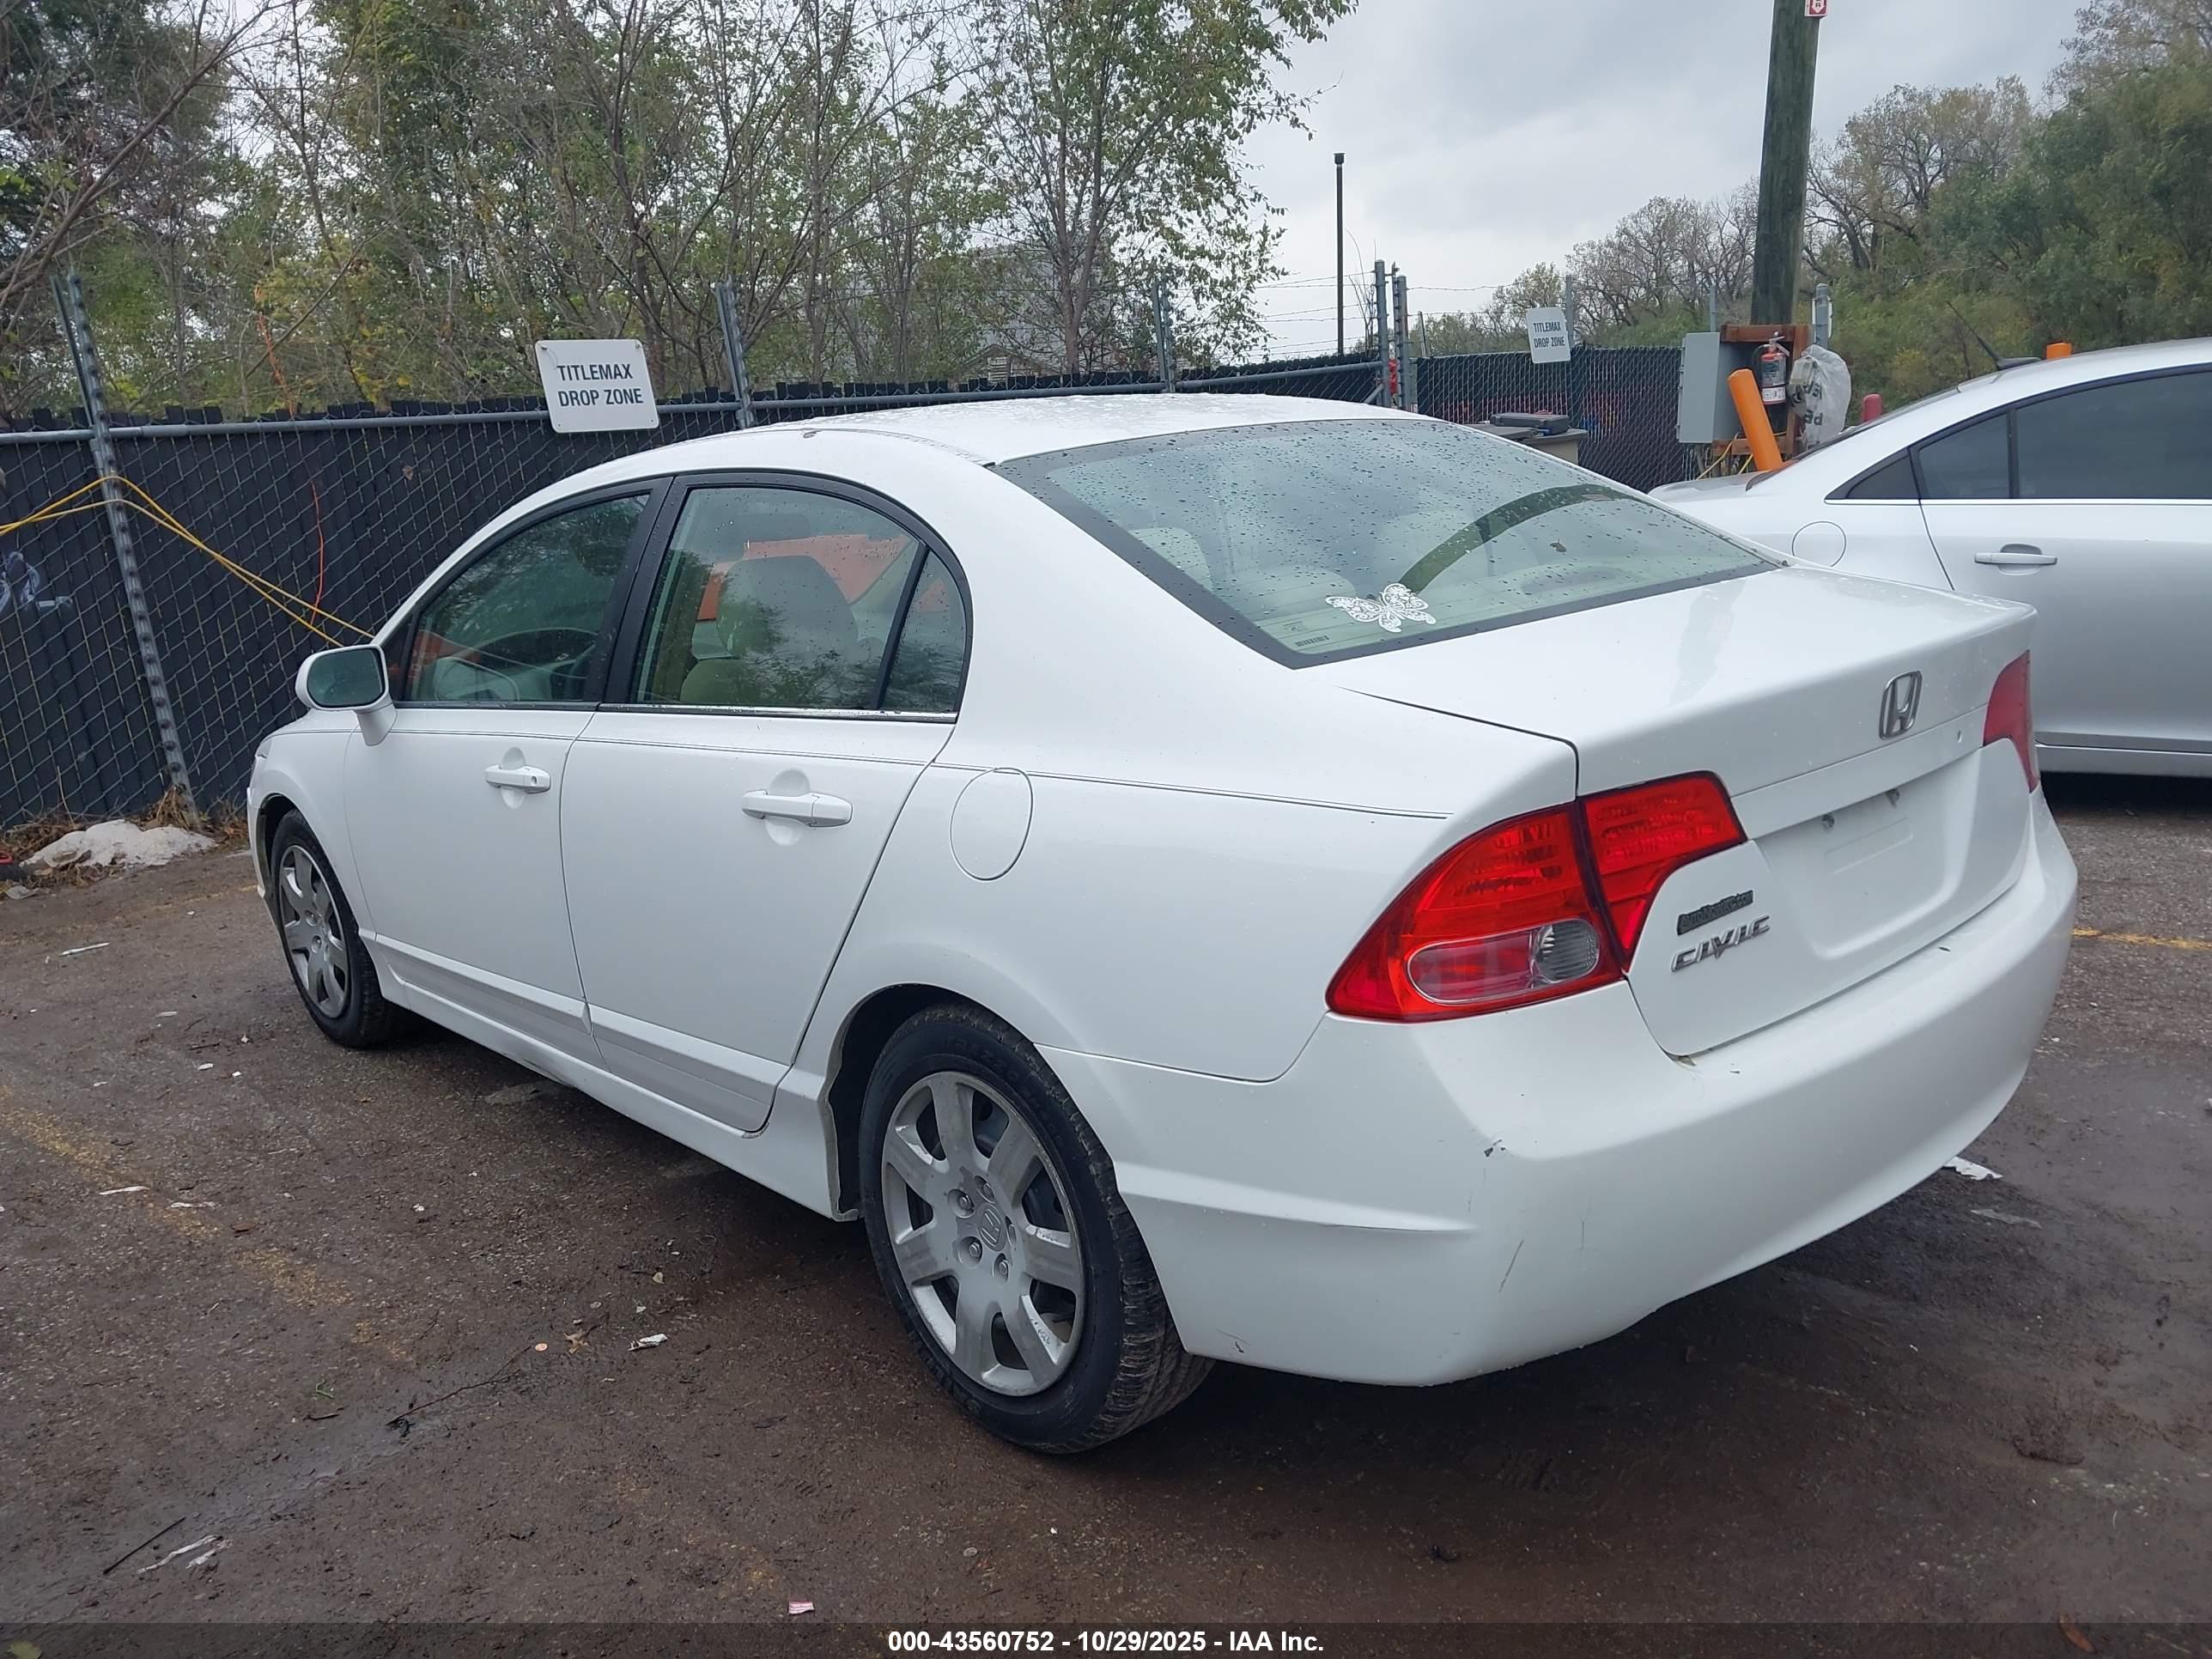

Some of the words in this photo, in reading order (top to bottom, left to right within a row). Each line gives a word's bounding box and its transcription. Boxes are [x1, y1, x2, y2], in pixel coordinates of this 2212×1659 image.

[1533, 322, 1562, 333] TITLEMAX
[1534, 337, 1550, 349] DROP
[1551, 337, 1566, 347] ZONE
[556, 363, 634, 381] TITLEMAX
[558, 389, 599, 407] DROP
[604, 388, 644, 405] ZONE
[1671, 914, 1771, 972] CIVIC
